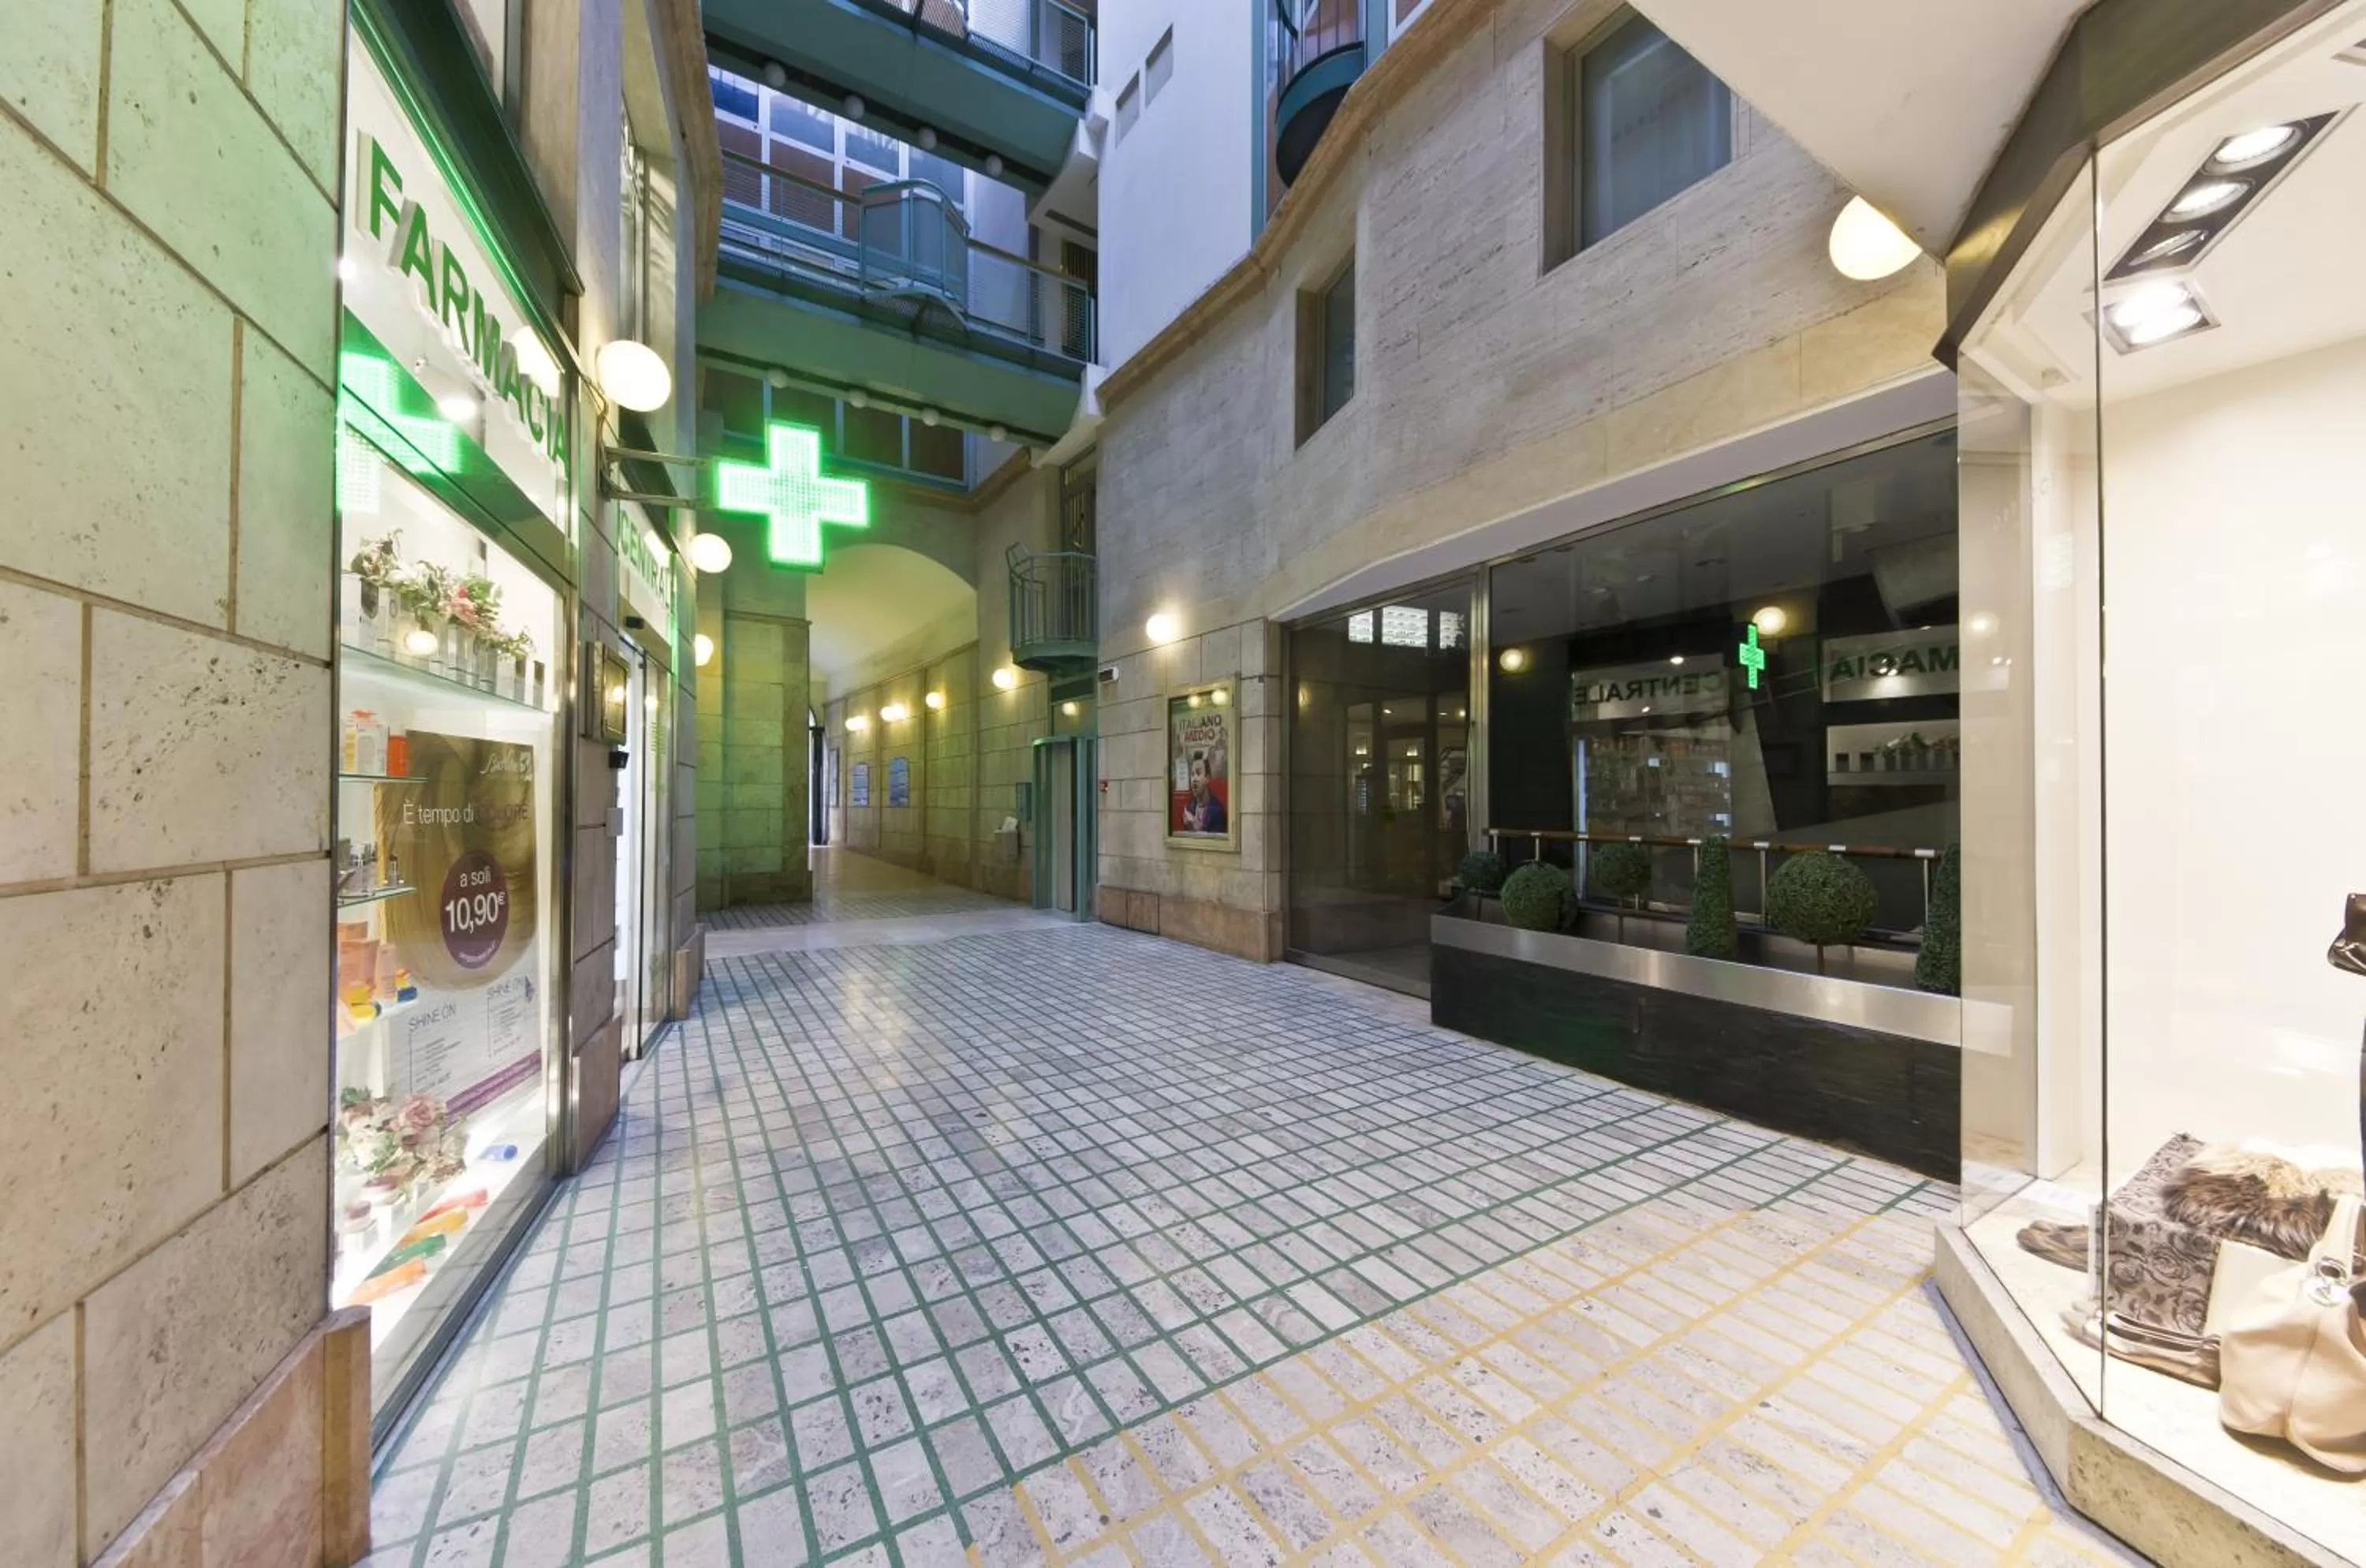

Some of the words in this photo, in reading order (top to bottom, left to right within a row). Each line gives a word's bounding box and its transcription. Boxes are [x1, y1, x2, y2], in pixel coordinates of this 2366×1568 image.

[368, 136, 569, 465] FARMACIA
[621, 510, 670, 610] CENTRAL
[1183, 727, 1215, 742] MEDIO
[403, 798, 415, 824] È
[418, 804, 460, 827] tempo
[463, 801, 473, 823] di
[460, 873, 468, 887] a
[471, 866, 491, 886] soli
[445, 892, 506, 935] 10,90€
[408, 1009, 439, 1032] SHINE
